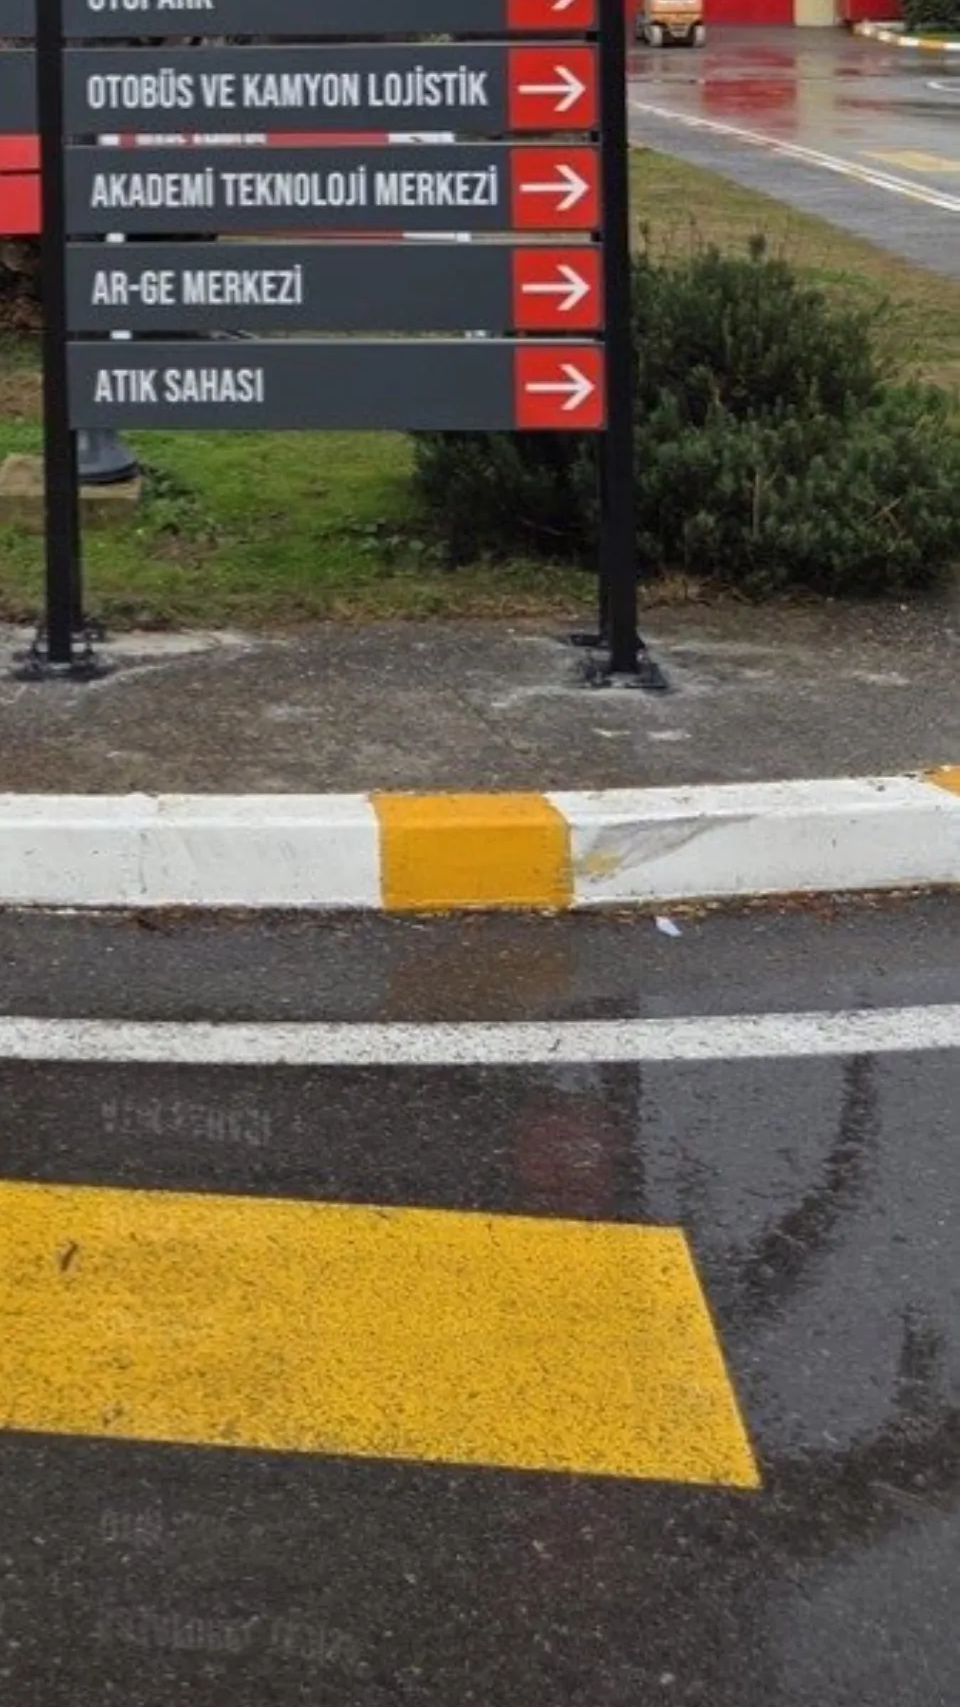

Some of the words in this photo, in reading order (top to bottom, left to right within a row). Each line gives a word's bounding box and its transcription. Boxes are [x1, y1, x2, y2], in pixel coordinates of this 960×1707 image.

[87, 67, 194, 110] OTOBÜS
[200, 73, 236, 108] VE
[242, 72, 360, 107] KAMYON
[367, 65, 488, 107] LOJİSTİK
[91, 167, 214, 208] AKADEMİ
[220, 165, 367, 207] TEKNOLOJİ
[374, 164, 498, 206] MERKEZİ
[91, 270, 176, 305] AR-GE
[182, 264, 303, 305] MERKEZİ
[94, 368, 158, 403] ATIK
[163, 368, 264, 403] SAHASI
